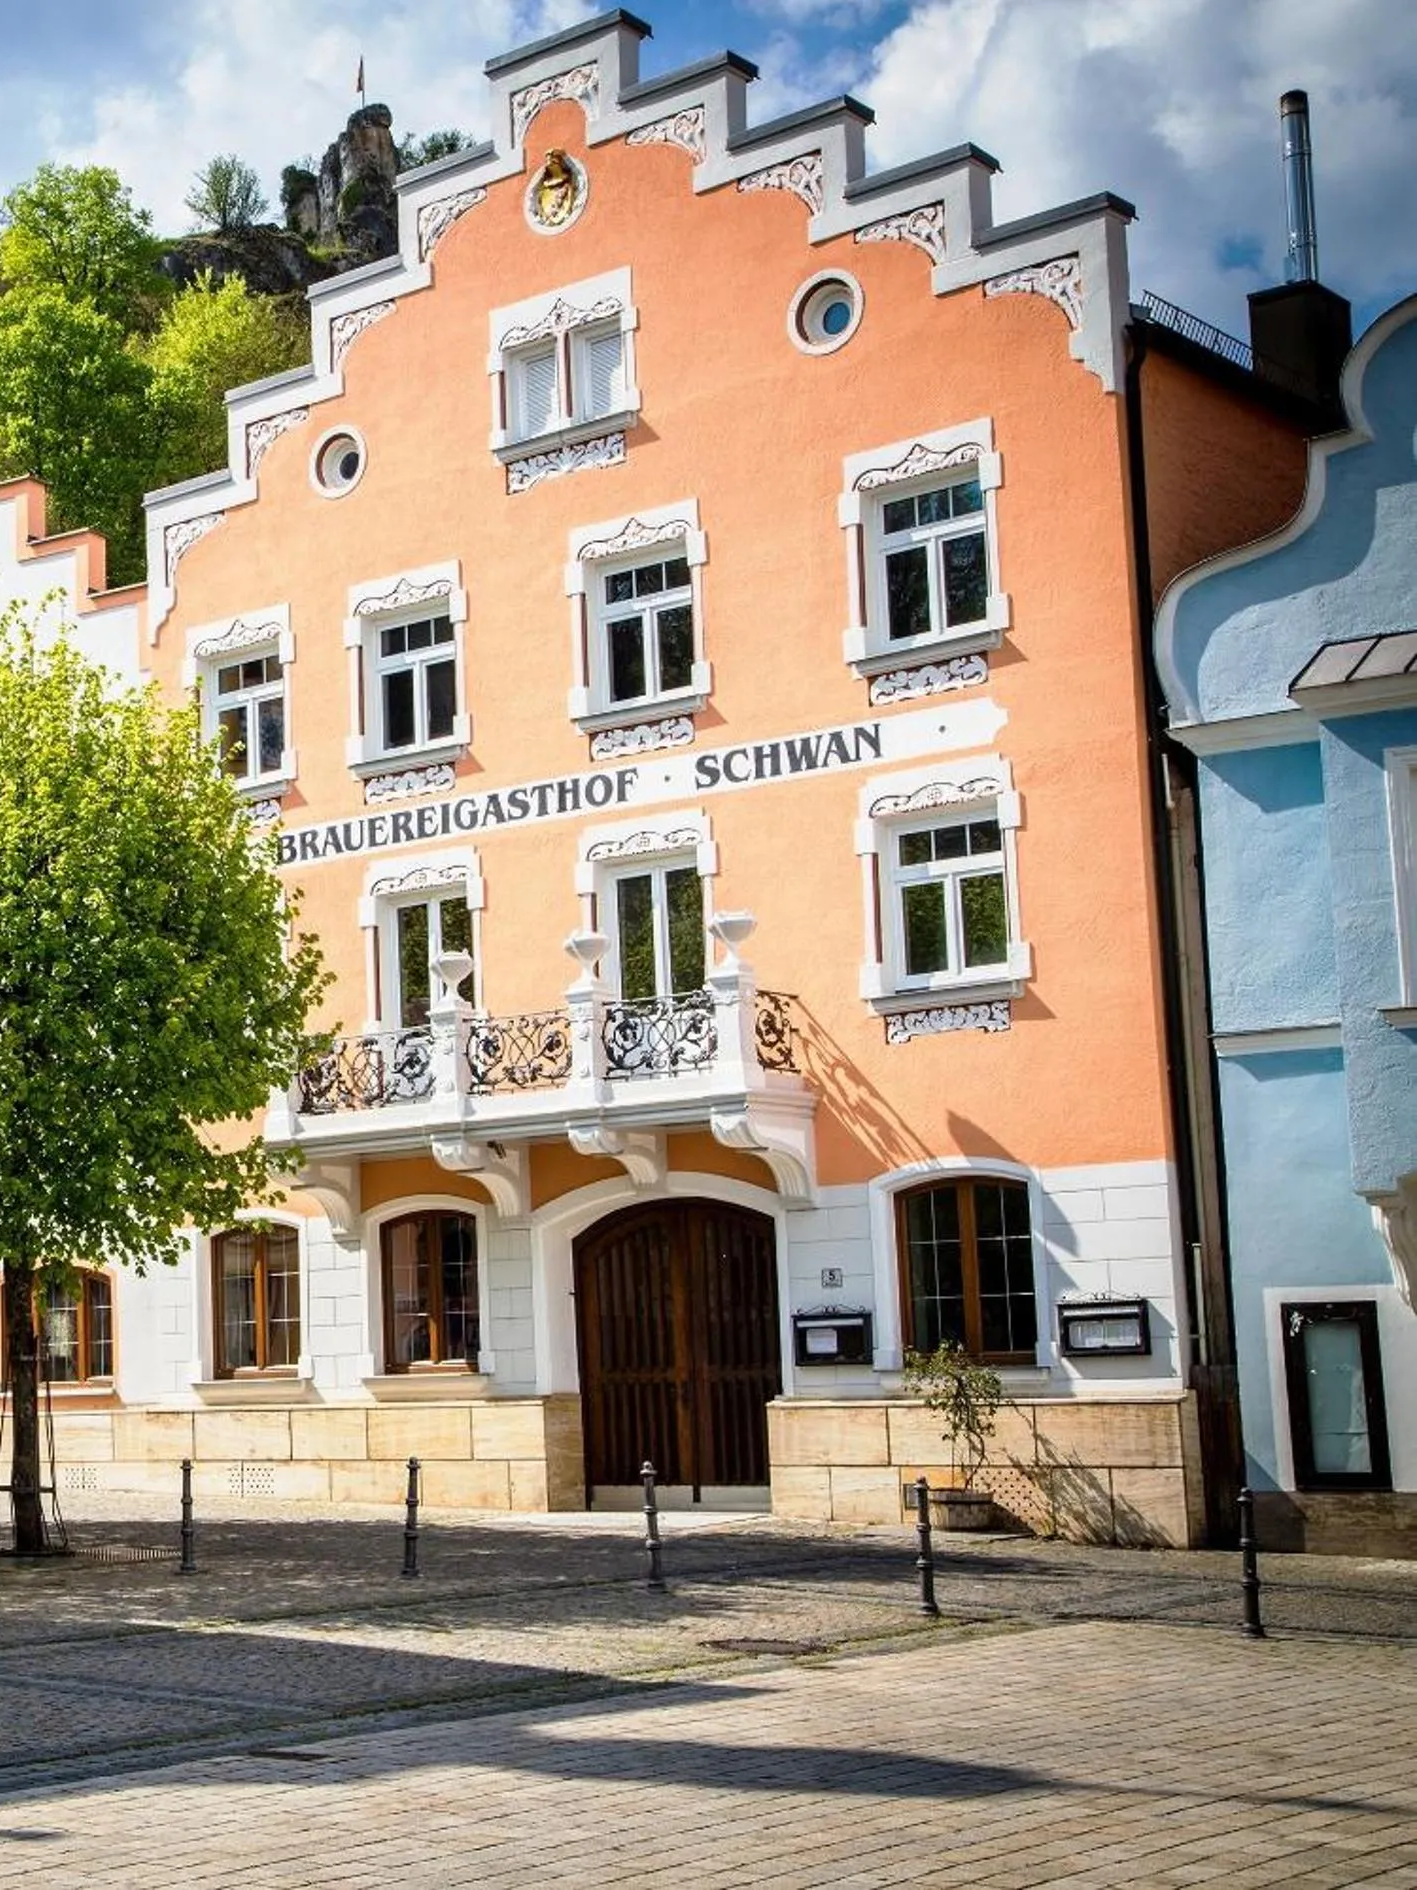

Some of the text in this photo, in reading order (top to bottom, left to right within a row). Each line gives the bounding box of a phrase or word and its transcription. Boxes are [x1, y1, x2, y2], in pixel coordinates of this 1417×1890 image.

[278, 722, 884, 865] BRAUEREIGASTHOF SCHWAN
[828, 1270, 836, 1282] 5
